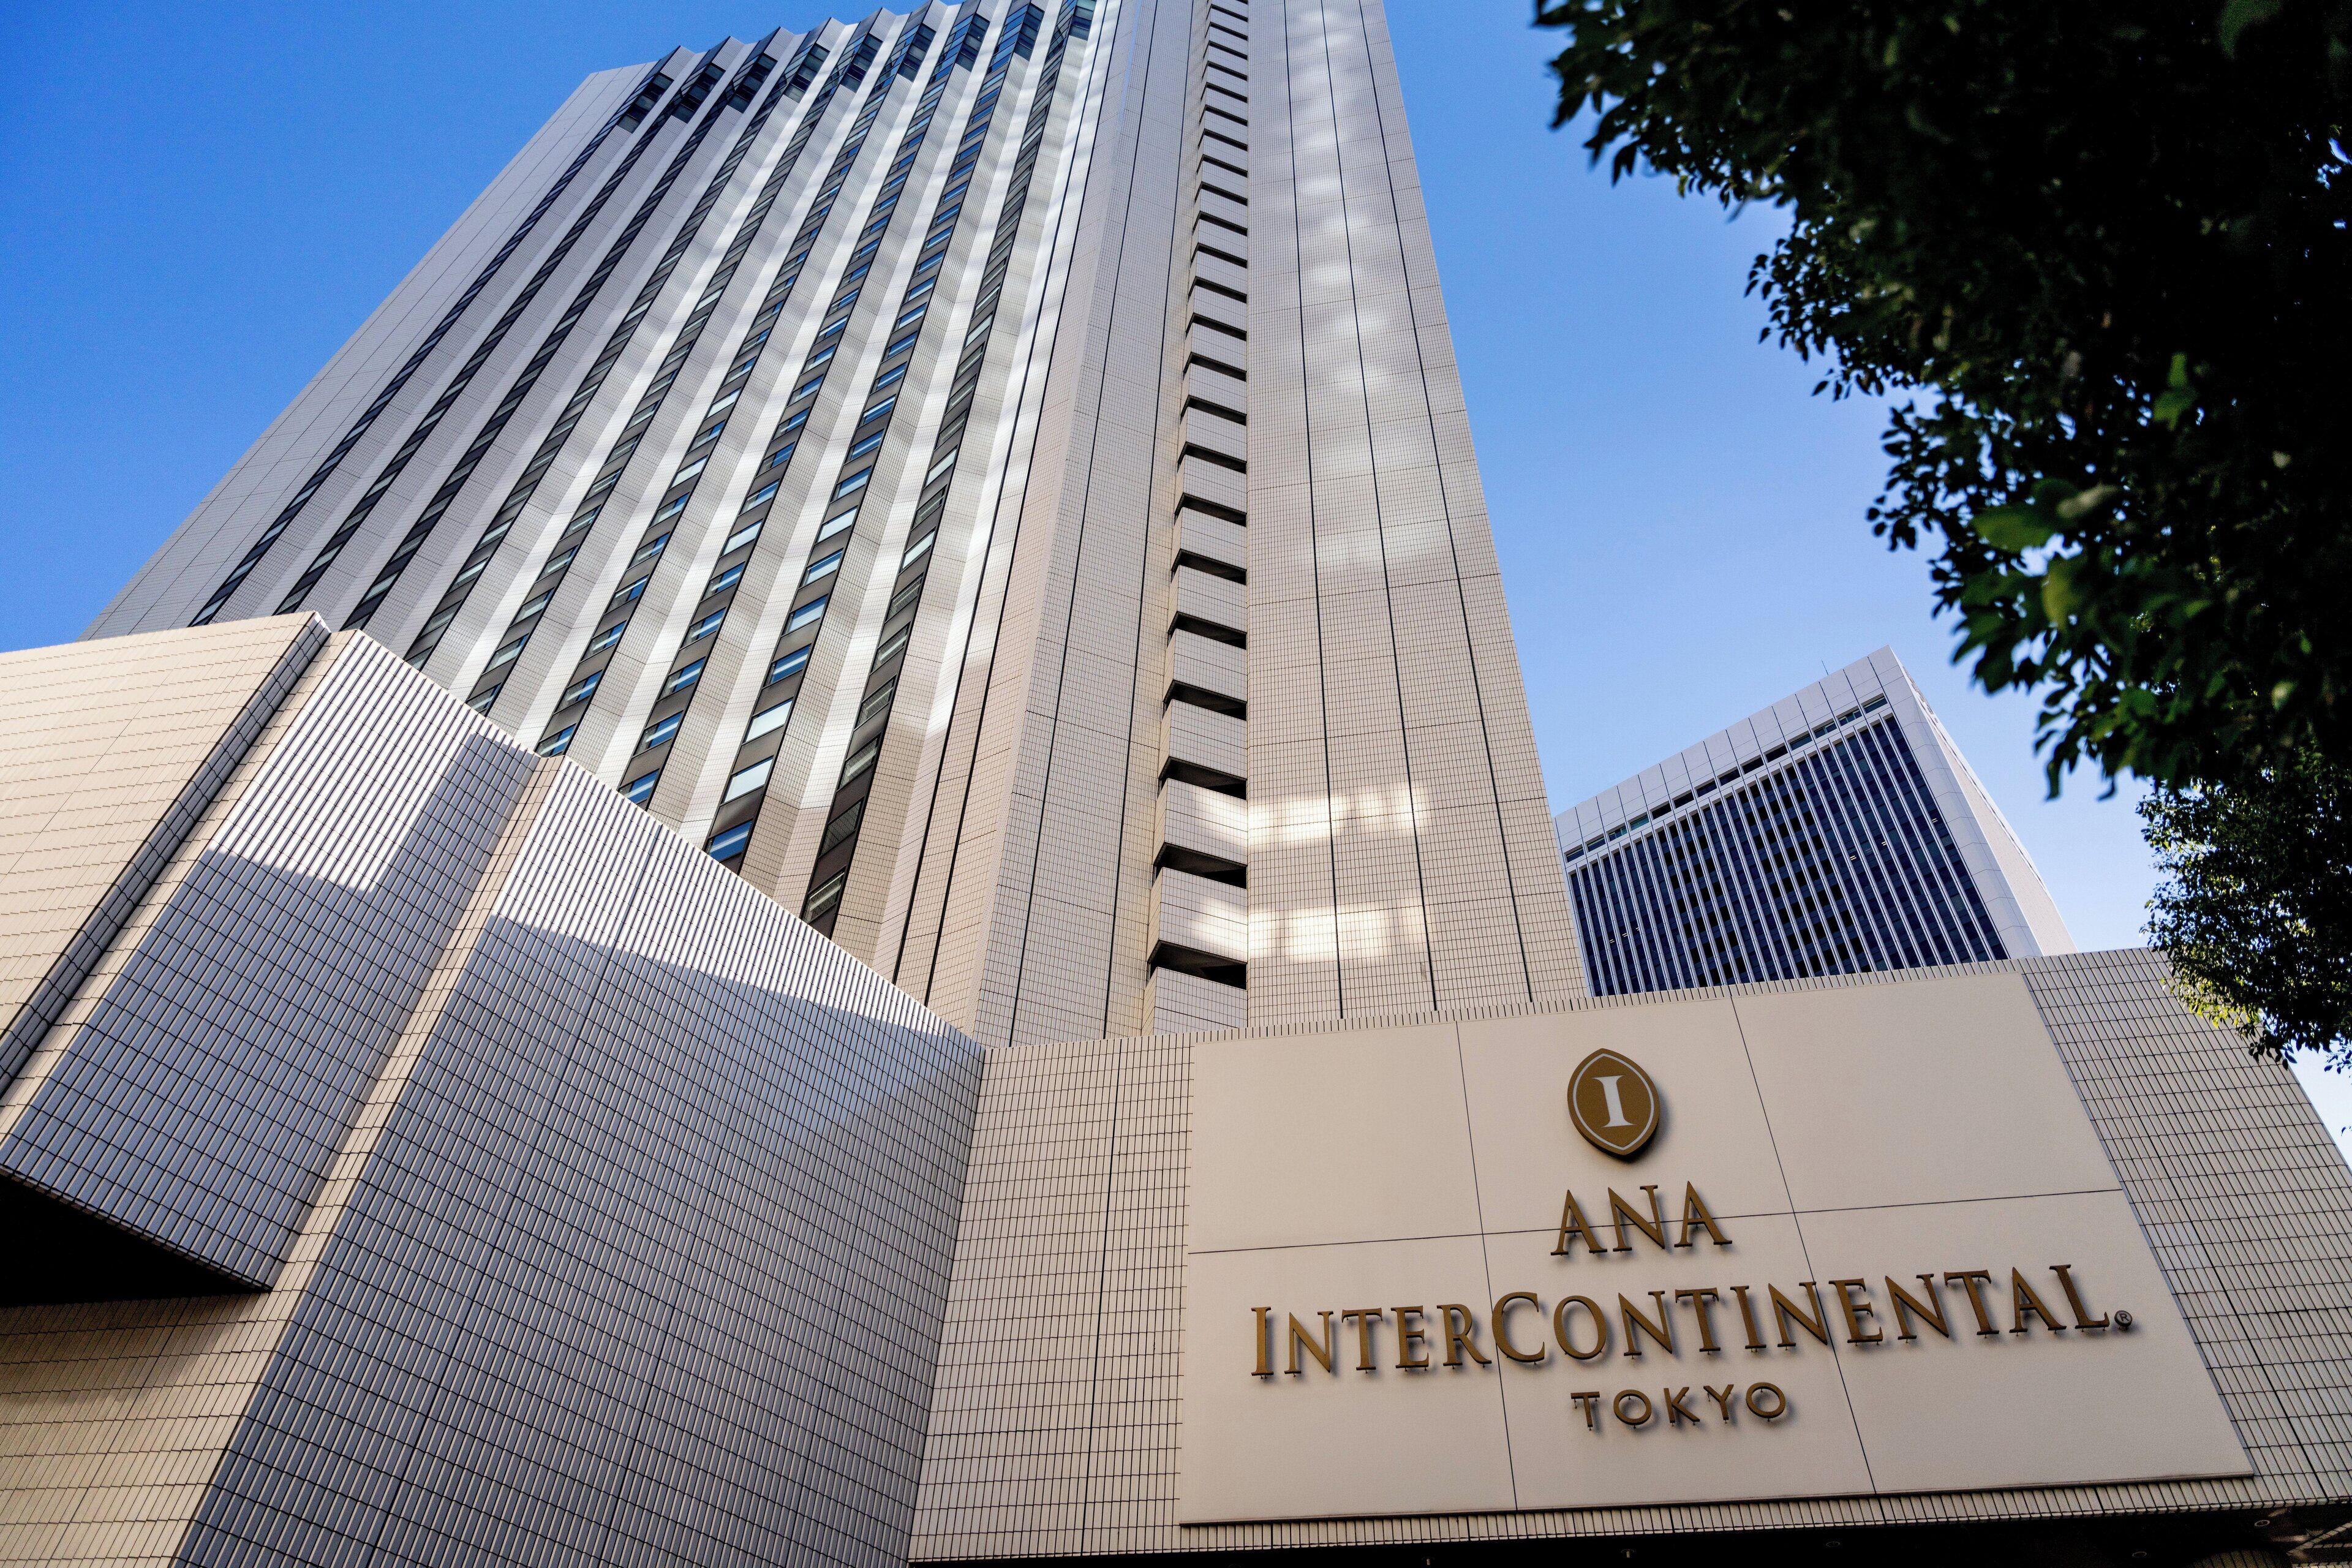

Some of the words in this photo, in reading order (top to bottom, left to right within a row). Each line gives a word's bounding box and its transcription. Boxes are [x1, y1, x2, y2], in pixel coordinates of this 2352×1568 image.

[1593, 1075, 1637, 1128] I
[1550, 1180, 1733, 1256] ANA
[1570, 1382, 1786, 1430] TOKYO
